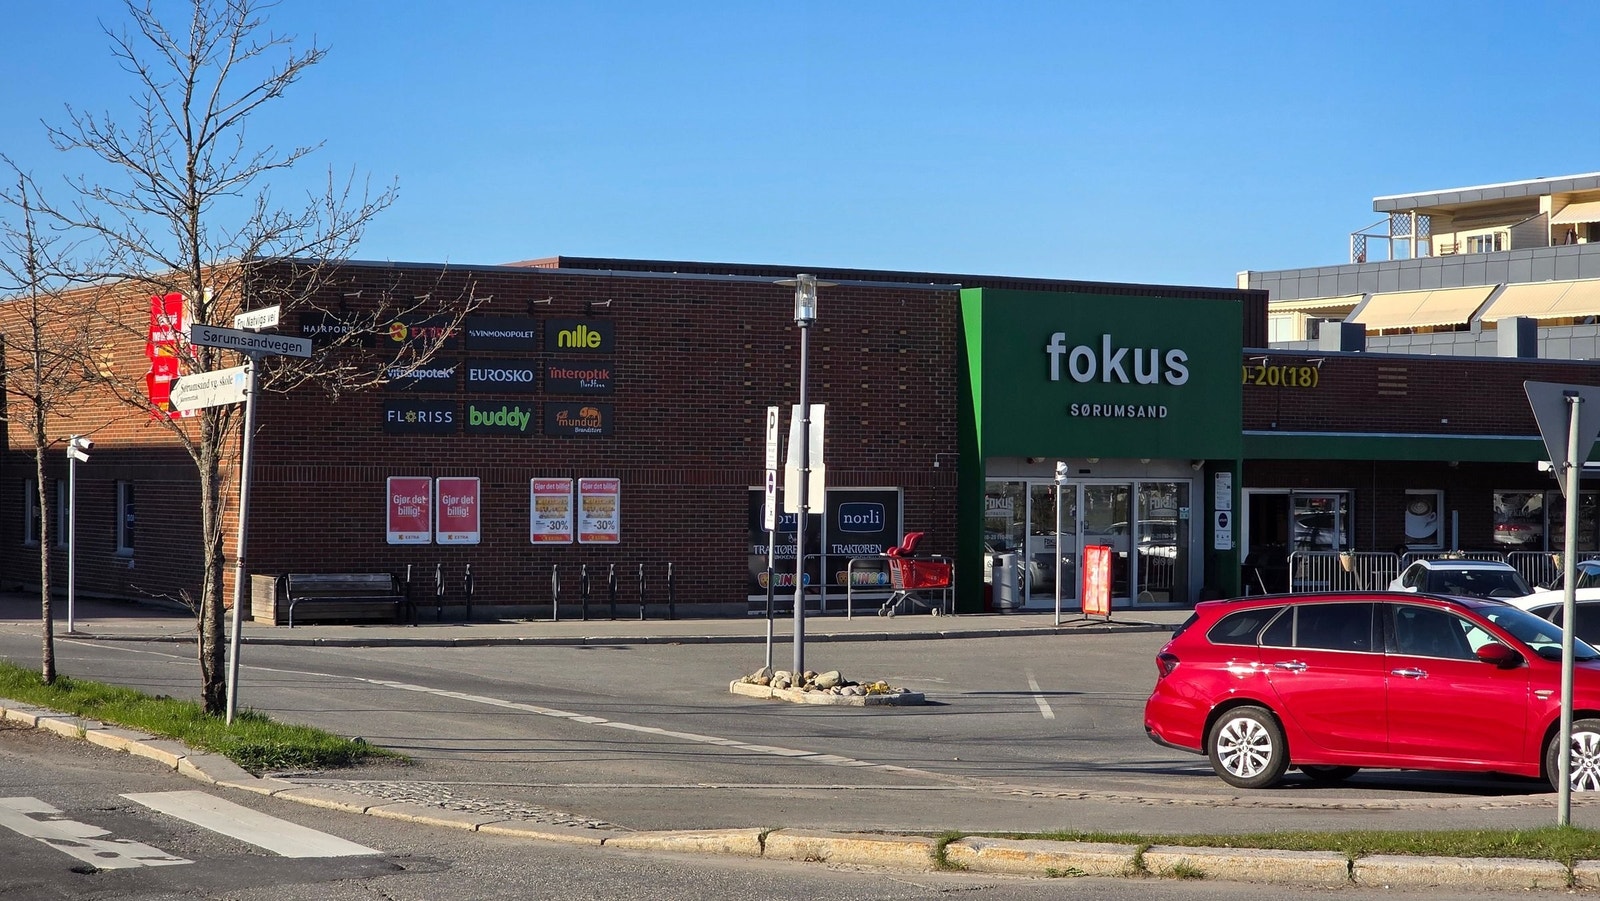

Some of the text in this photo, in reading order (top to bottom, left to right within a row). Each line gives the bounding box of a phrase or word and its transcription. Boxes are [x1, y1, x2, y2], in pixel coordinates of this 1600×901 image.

[246, 314, 266, 327] Natvigs
[267, 311, 276, 323] vei
[303, 324, 350, 334] HAIRPOR
[411, 327, 456, 338] EXTR
[475, 330, 534, 338] VINMONOPOLET
[203, 330, 303, 353] Sørumsandvegen
[558, 325, 602, 348] nille
[1046, 332, 1190, 386] fokus
[470, 369, 534, 382] EUROSKO
[181, 378, 210, 393] Sørumsand
[219, 375, 234, 387] skole
[387, 410, 453, 423] FLORISS
[1070, 403, 1168, 418] SØRUMSAND
[469, 405, 530, 432] buddy
[769, 411, 776, 441] P
[534, 482, 547, 491] Gjør
[546, 482, 556, 490] det
[582, 482, 595, 491] Gjør
[393, 494, 426, 506] Gjør det
[442, 495, 475, 507] Gjør det
[985, 496, 1015, 510] FOKUS
[397, 506, 421, 518] billig!
[447, 506, 470, 518] billig!
[843, 509, 881, 524] norli
[546, 520, 570, 531] -30%
[593, 519, 616, 531] -30%
[753, 545, 798, 555] TRATØRE
[831, 544, 882, 554] TRAKTØREN
